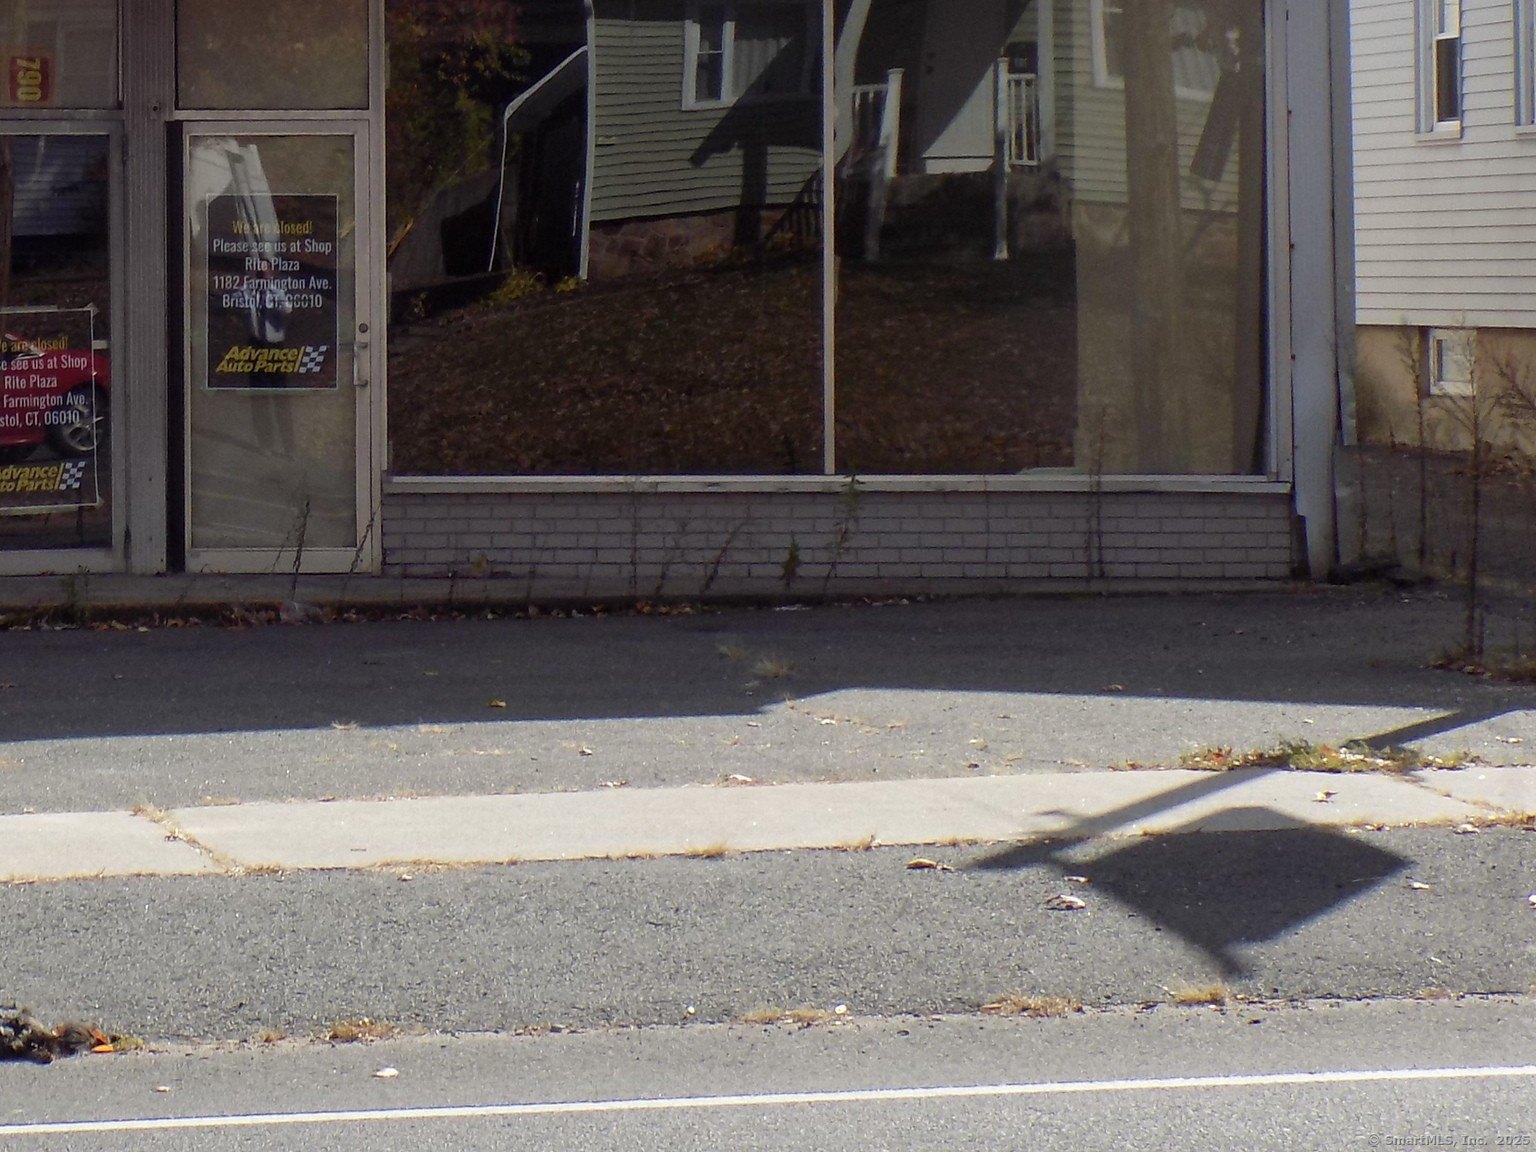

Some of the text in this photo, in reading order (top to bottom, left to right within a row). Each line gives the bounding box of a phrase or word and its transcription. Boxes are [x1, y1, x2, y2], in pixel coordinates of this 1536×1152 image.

[213, 239, 332, 255] Please see us at Shop
[245, 257, 299, 271] Rite Plaza
[213, 276, 332, 292] 1182 Farmington Ave.
[224, 346, 300, 361] Advance
[10, 359, 30, 371] see
[32, 358, 44, 370] us
[48, 356, 59, 370] at
[61, 355, 87, 370] Shop
[216, 360, 296, 373] Auto Parts
[4, 374, 57, 389] Rite Plaza
[3, 394, 63, 410] Farmington
[66, 392, 88, 405] Ave.
[44, 411, 80, 426] 06010
[16, 478, 56, 492] Parts
